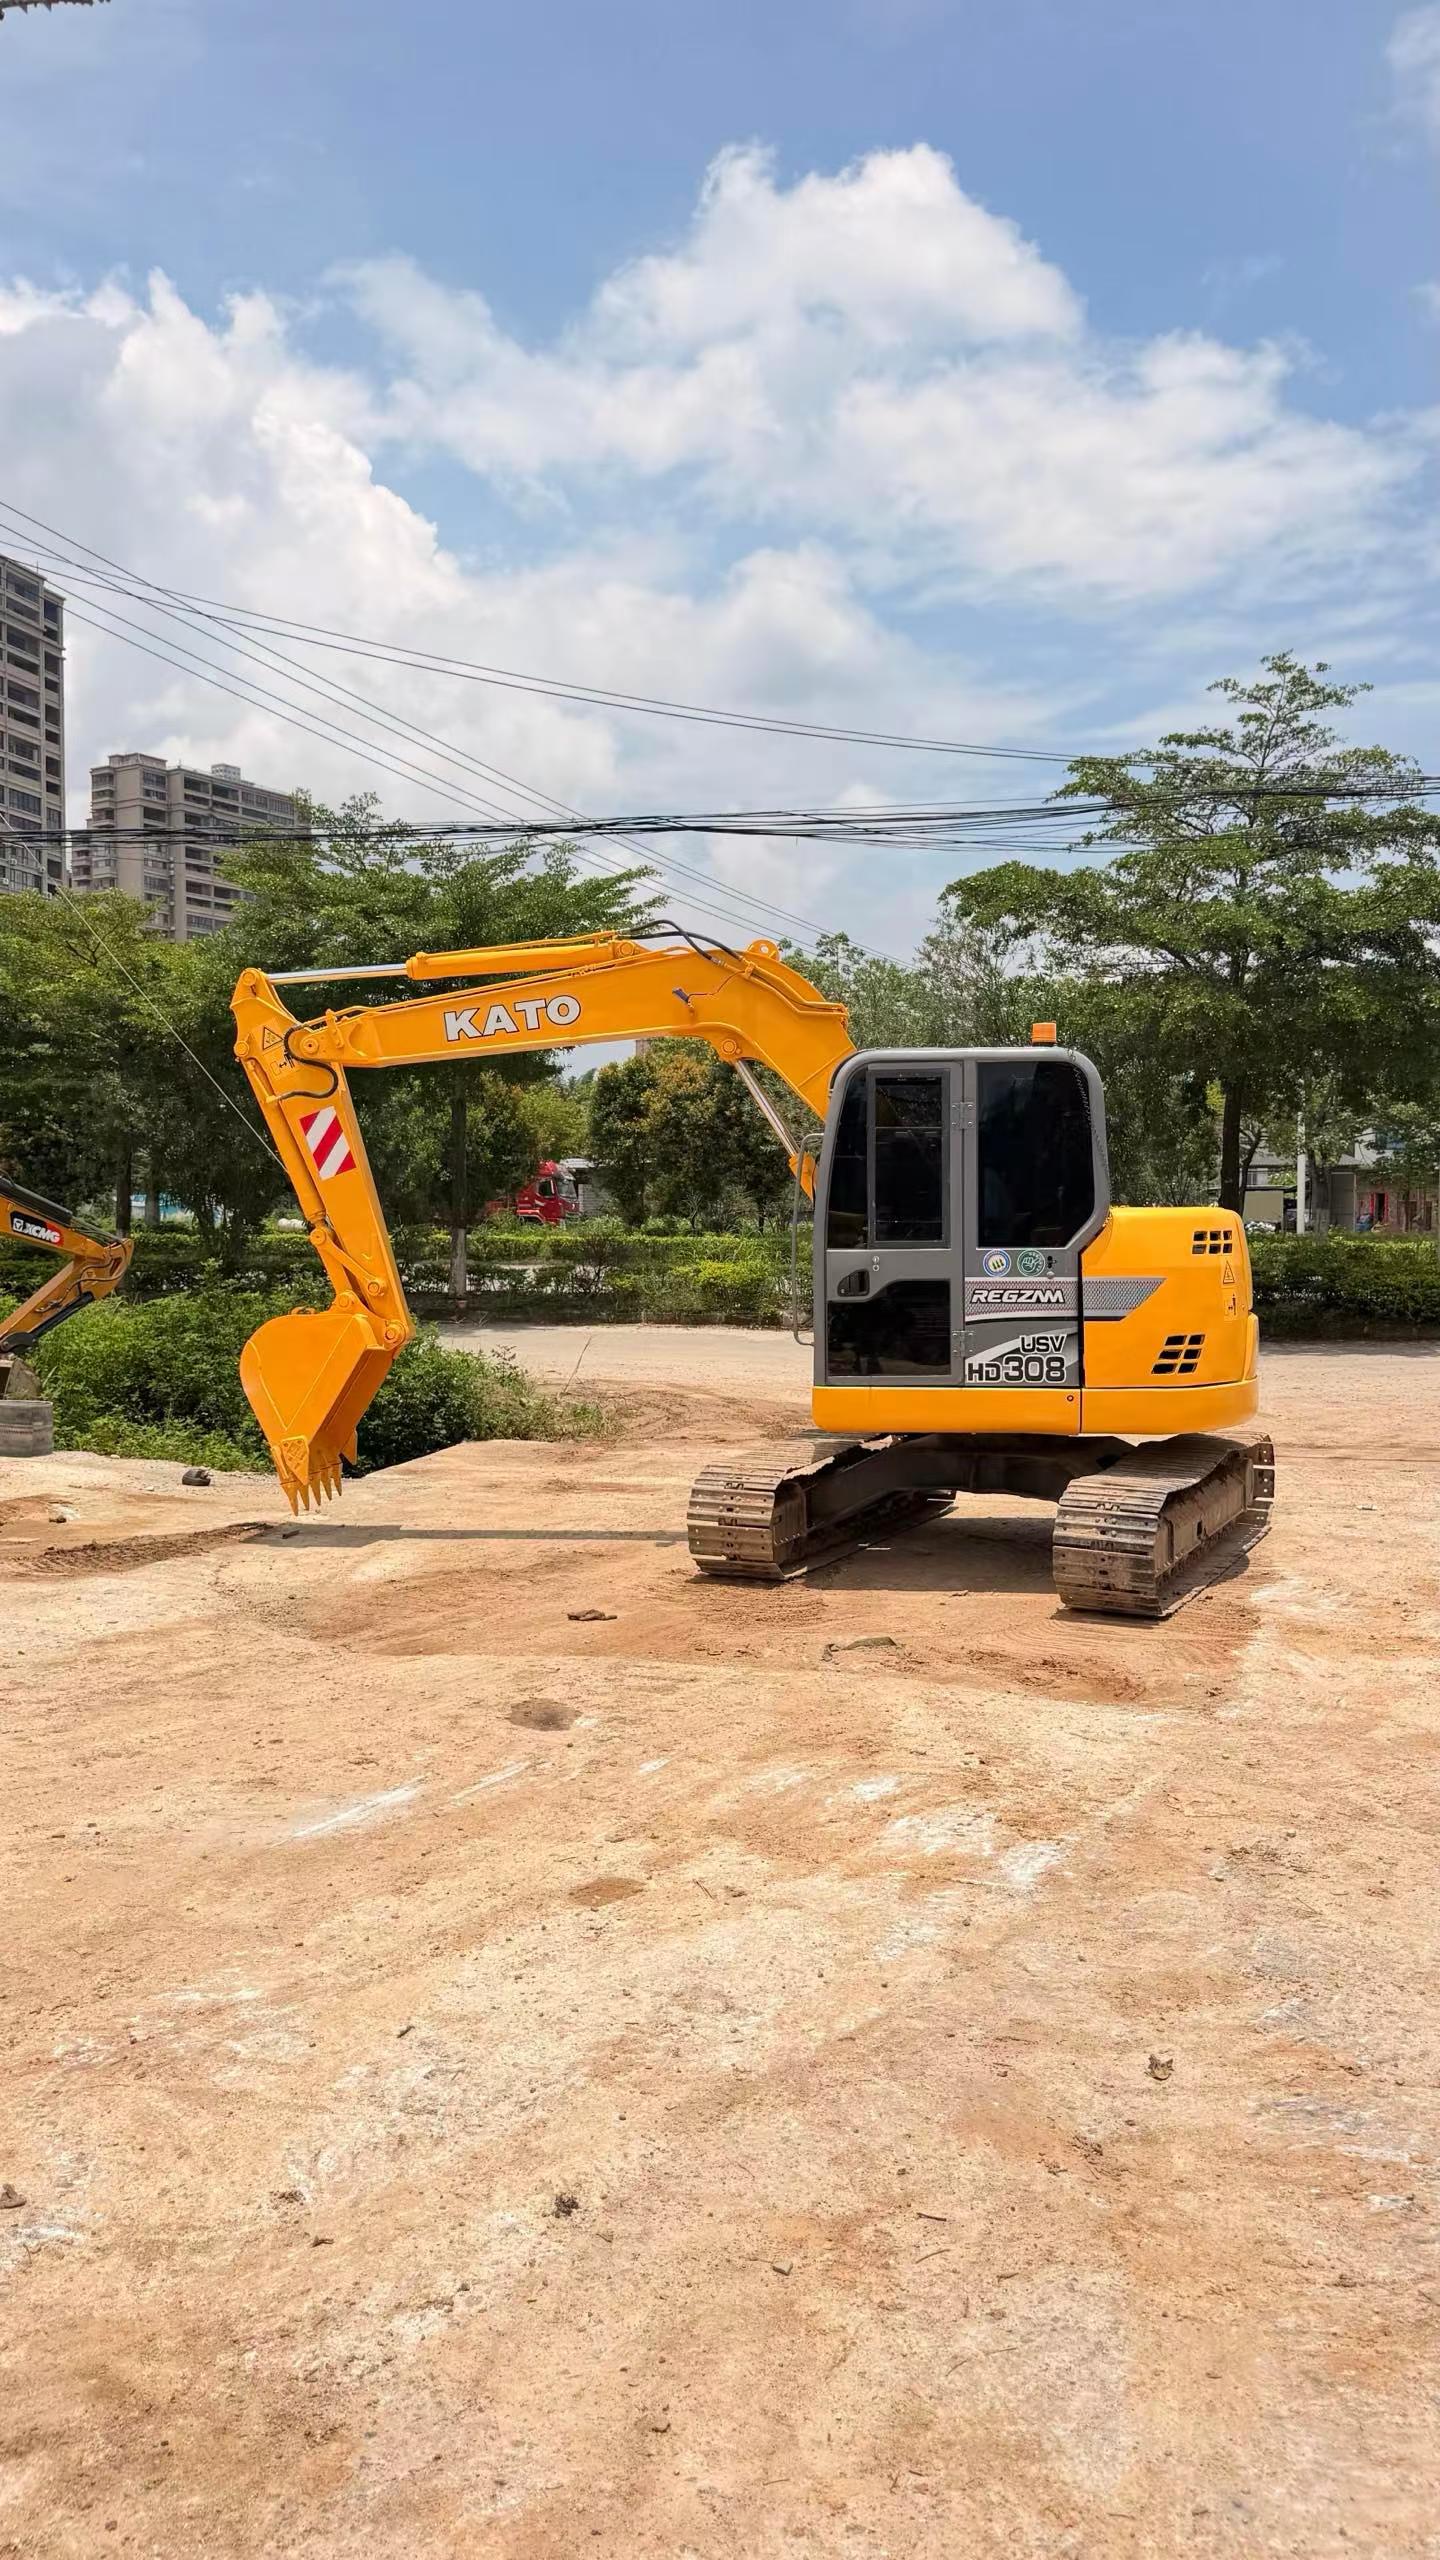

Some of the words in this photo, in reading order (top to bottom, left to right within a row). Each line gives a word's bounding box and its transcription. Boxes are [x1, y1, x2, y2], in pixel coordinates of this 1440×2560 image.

[444, 995, 581, 1042] KATO
[23, 1222, 61, 1243] XCMG
[1020, 1334, 1067, 1353] USV
[967, 1354, 1066, 1382] HD308
